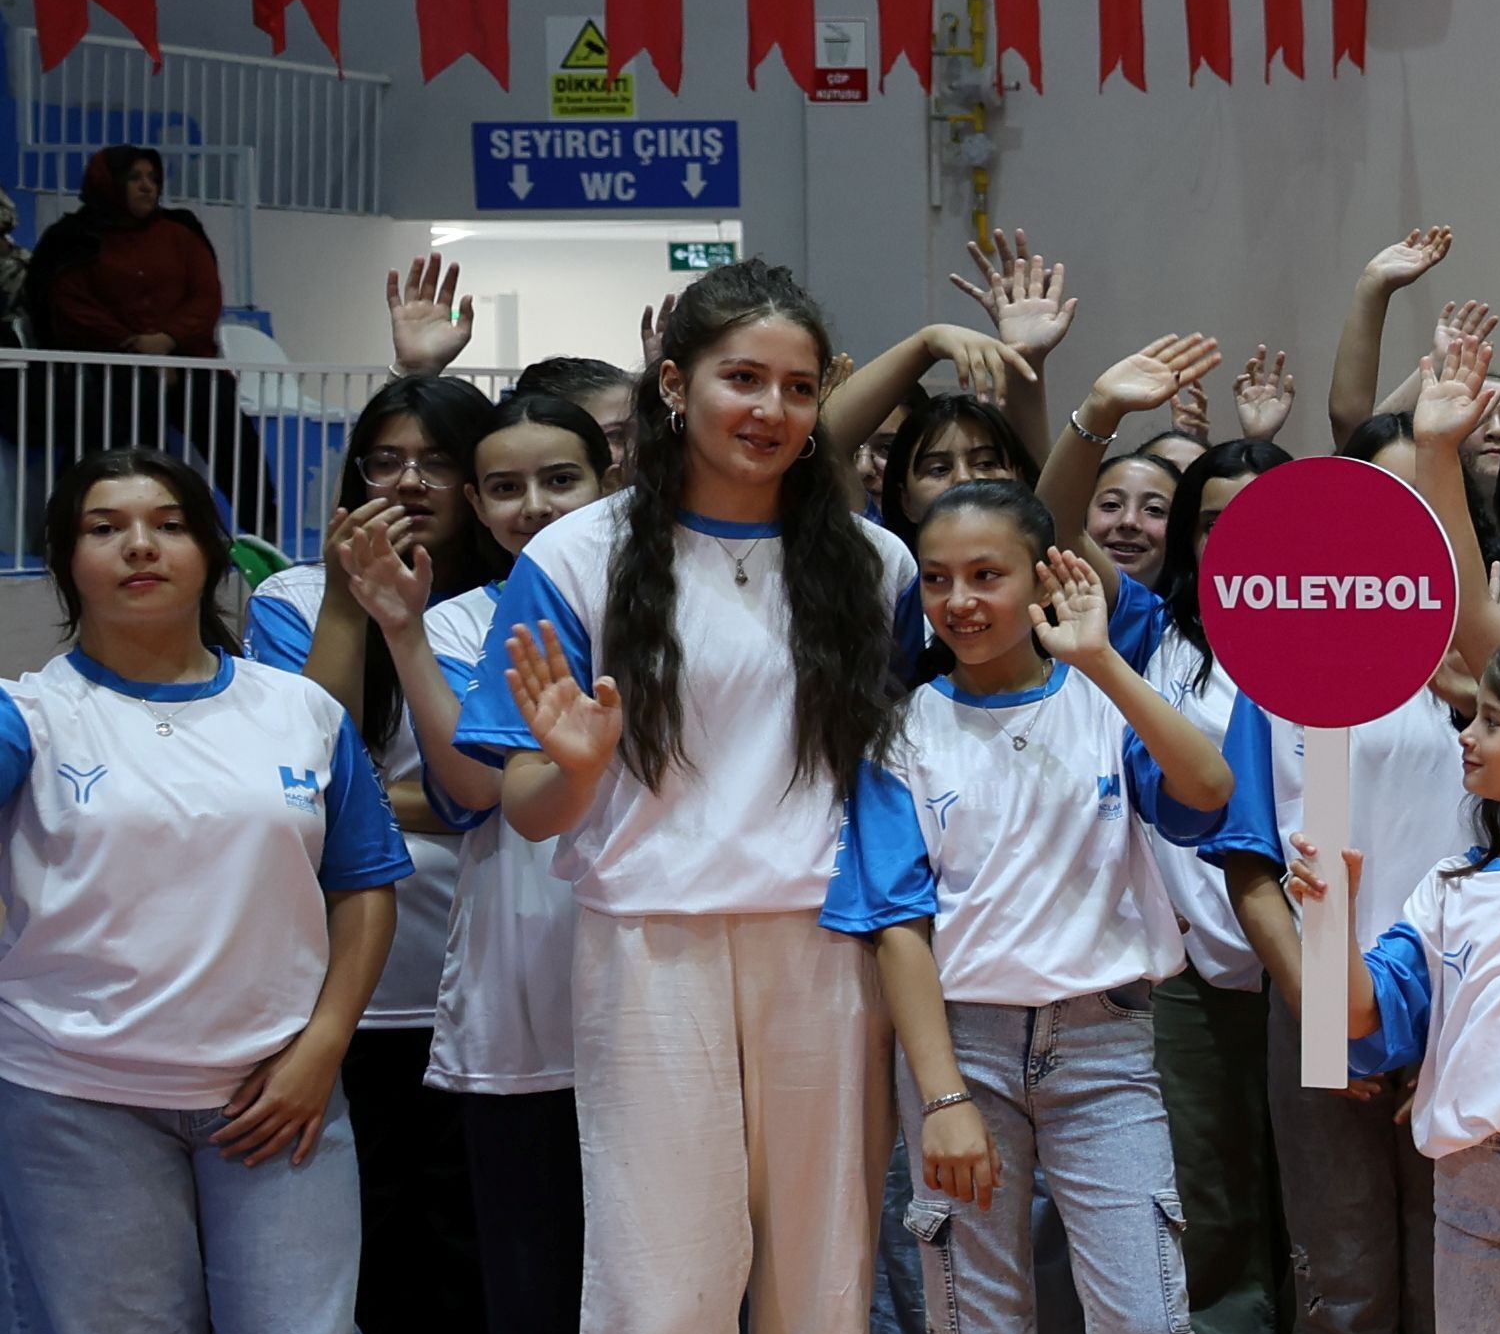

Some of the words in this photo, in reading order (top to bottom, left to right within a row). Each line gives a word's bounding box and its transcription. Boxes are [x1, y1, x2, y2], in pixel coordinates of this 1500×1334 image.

[633, 127, 724, 165] ÇIKIŞ
[579, 171, 637, 201] WC
[1213, 575, 1442, 609] VOLEYBOL
